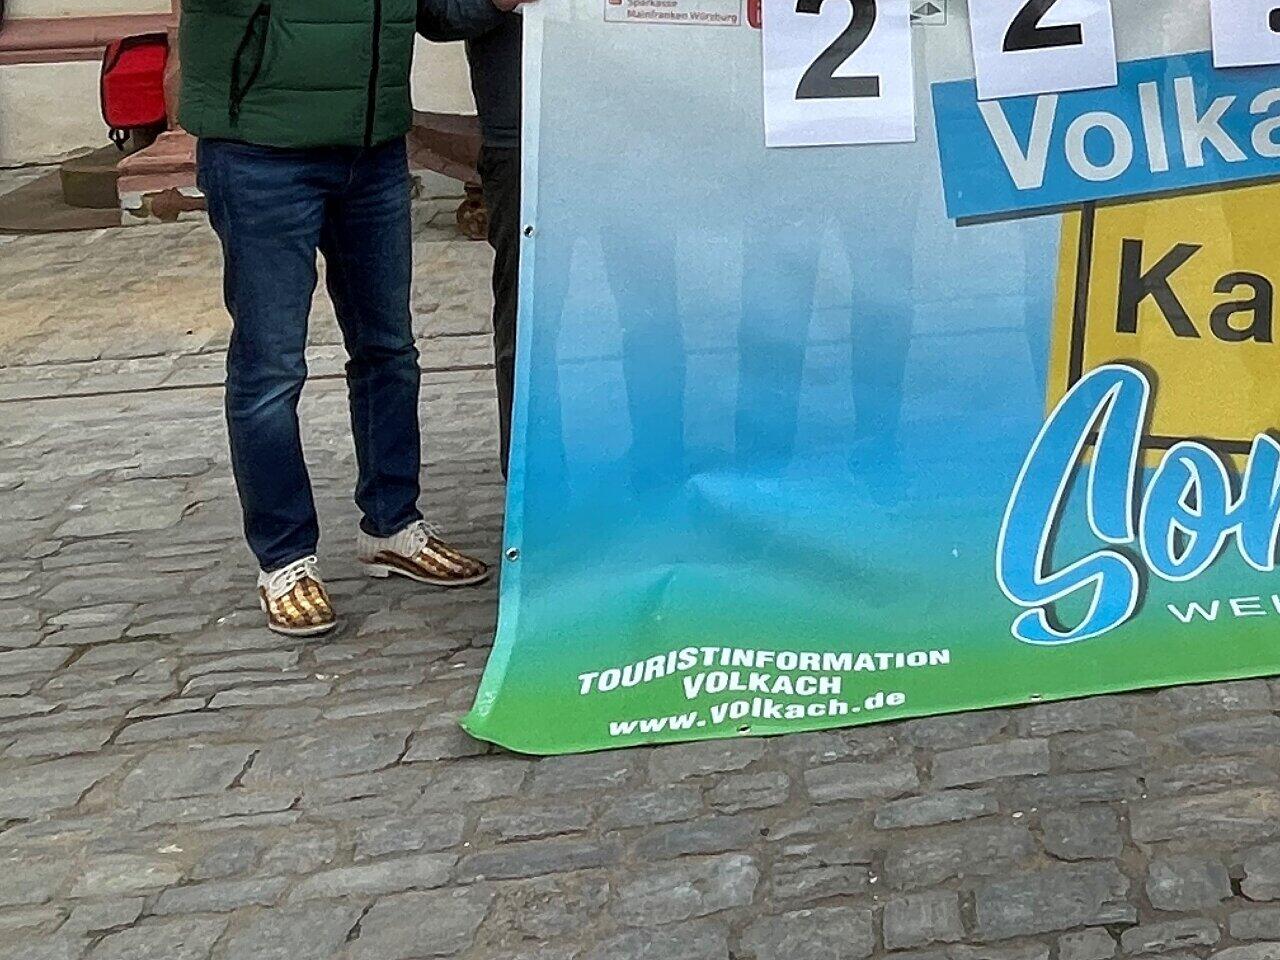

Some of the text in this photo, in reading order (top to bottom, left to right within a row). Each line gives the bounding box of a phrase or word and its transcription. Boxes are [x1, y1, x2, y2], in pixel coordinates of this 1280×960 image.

[627, 9, 738, 23] Mainfranken Würzburg
[577, 646, 951, 696] TOURISTINFORMATION
[682, 670, 842, 700] VOLKACH
